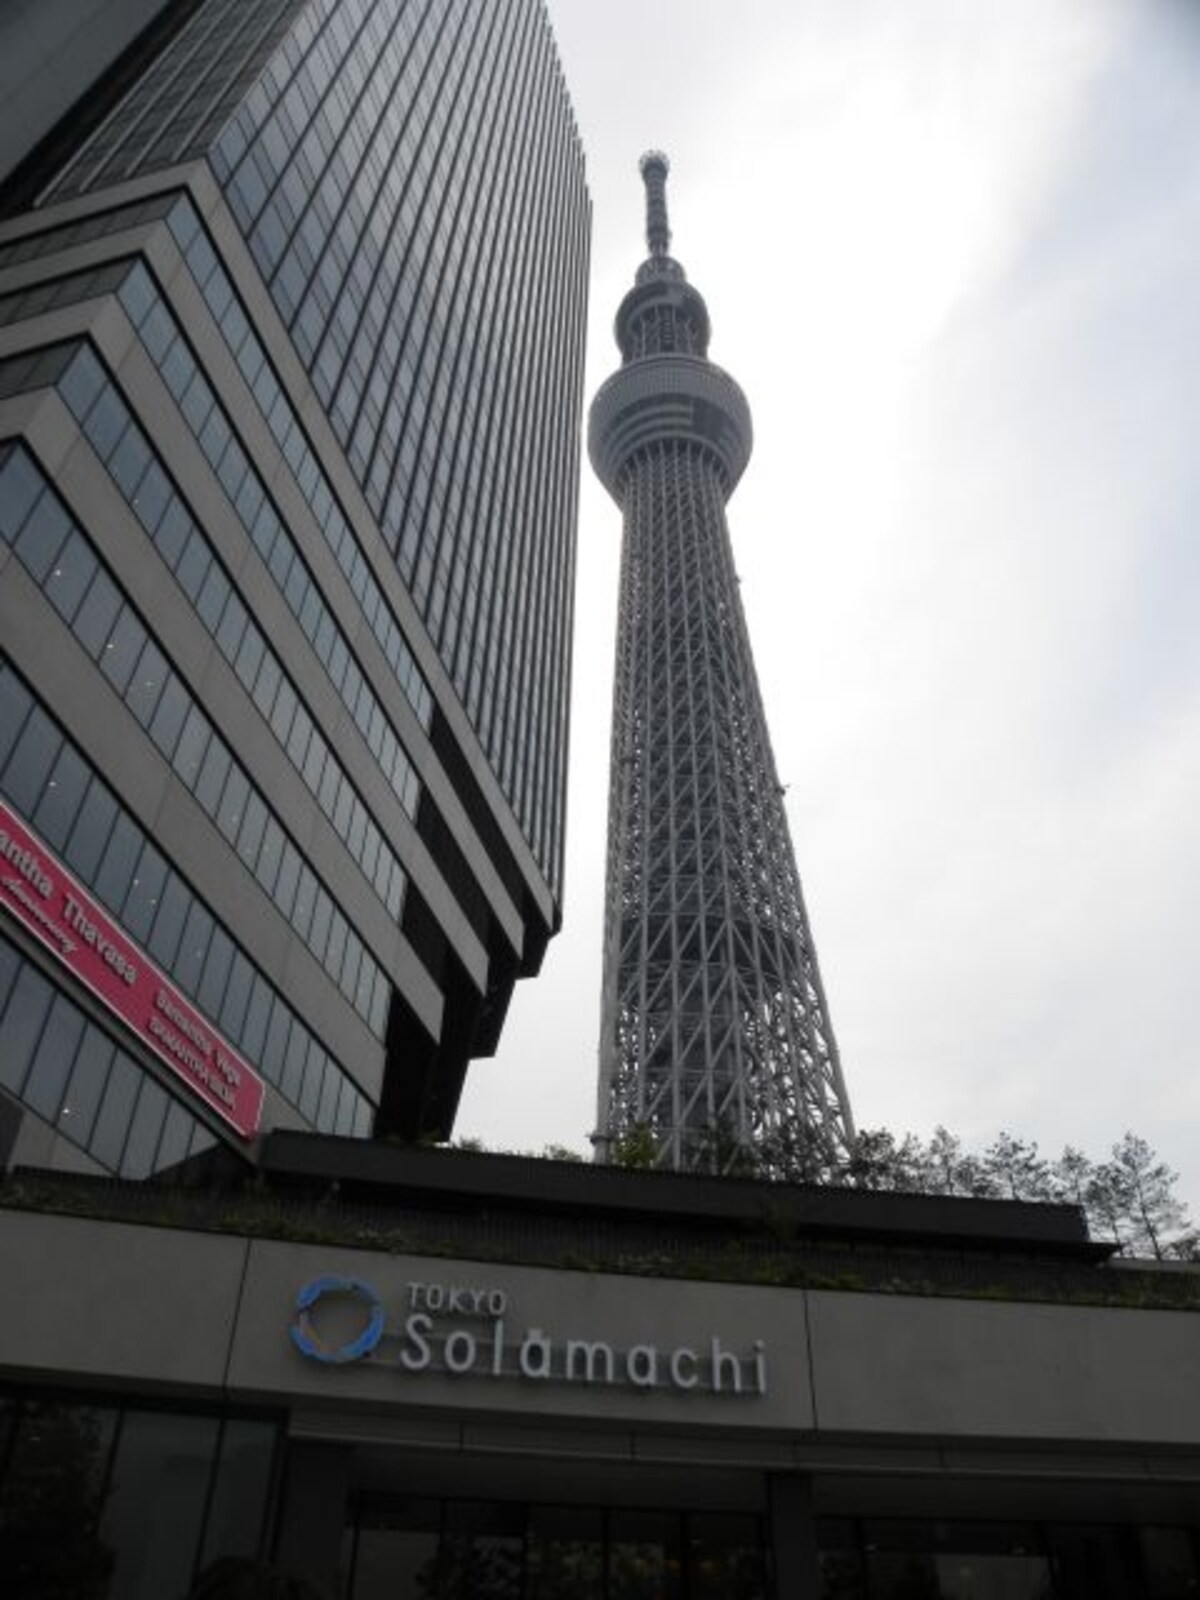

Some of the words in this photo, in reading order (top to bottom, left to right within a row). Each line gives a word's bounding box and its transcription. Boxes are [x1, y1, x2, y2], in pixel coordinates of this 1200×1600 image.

[64, 893, 137, 986] Thavasa
[406, 1281, 506, 1315] TOKYO
[401, 1313, 766, 1393] Solamachi
